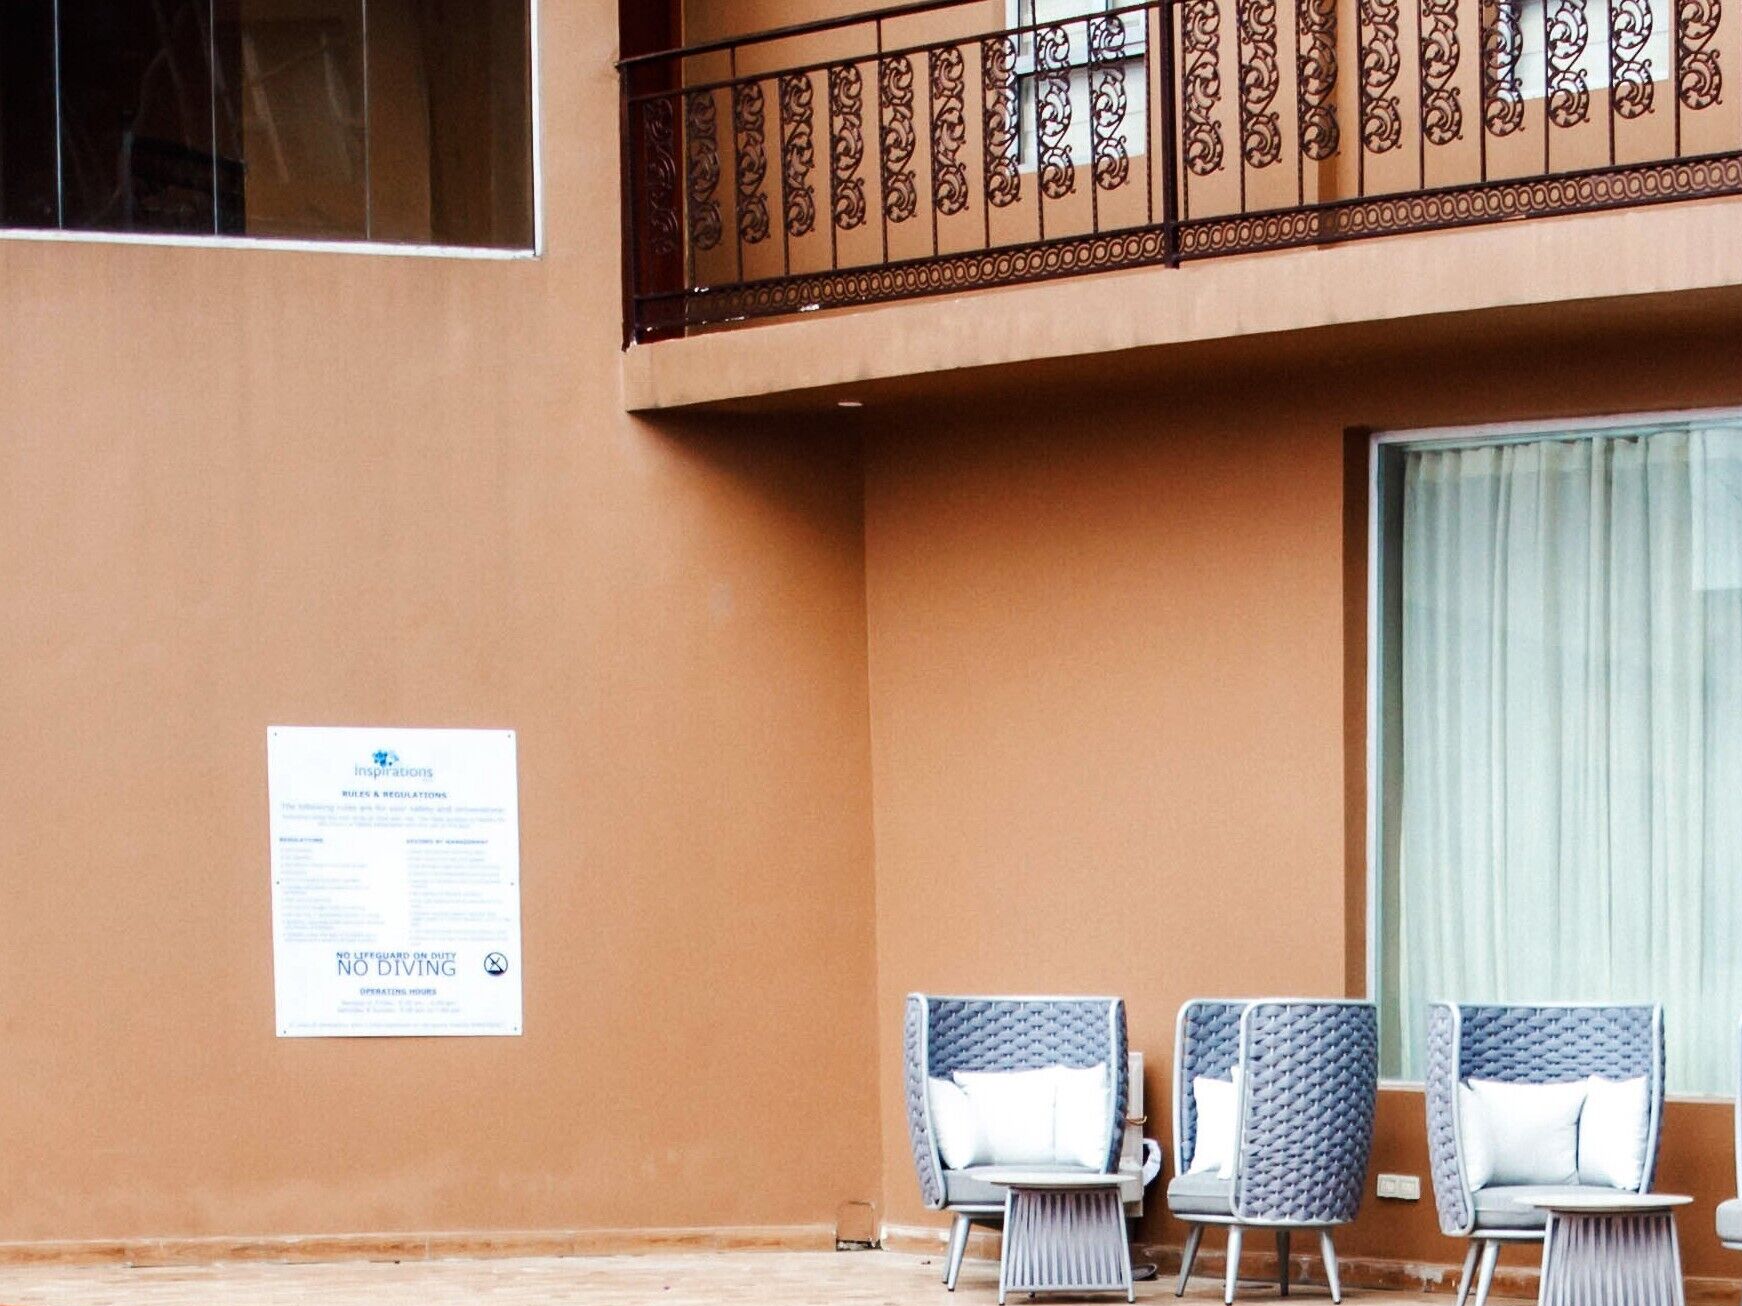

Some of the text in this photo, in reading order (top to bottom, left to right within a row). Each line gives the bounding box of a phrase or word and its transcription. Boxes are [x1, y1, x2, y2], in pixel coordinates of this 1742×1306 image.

[354, 763, 434, 779] Inspirations
[383, 791, 447, 799] REGULATIONS
[354, 952, 410, 960] LIFEGUARD
[431, 952, 456, 960] DUTY
[338, 960, 456, 976] NO DIVING
[360, 987, 437, 996] OPERATING HOURS
